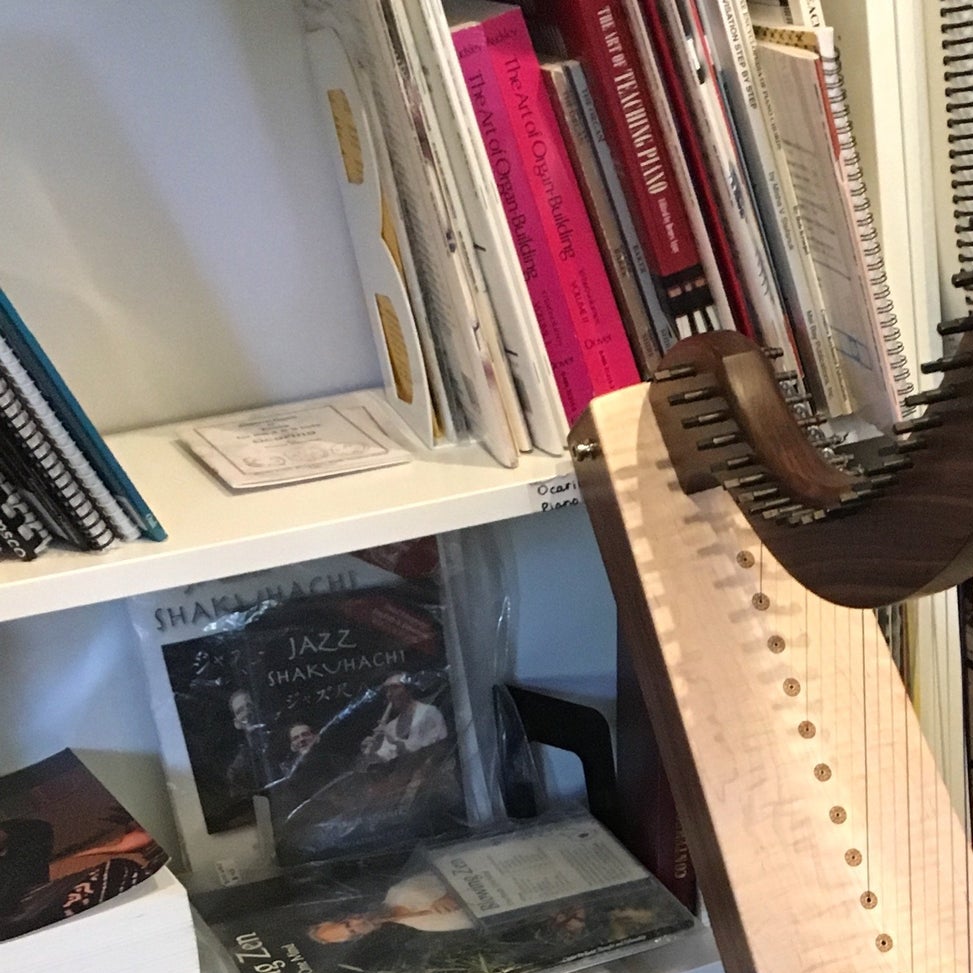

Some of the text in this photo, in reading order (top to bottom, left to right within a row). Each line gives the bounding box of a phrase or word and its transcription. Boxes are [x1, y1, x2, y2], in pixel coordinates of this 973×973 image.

[597, 5, 614, 31] THE
[604, 33, 622, 57] ART
[612, 53, 626, 69] OF
[734, 40, 746, 68] STEP
[741, 70, 751, 83] BY
[746, 85, 757, 109] STEP
[614, 69, 652, 148] TEACHING
[469, 70, 486, 99] The
[478, 107, 497, 135] Art
[489, 138, 505, 156] of
[497, 158, 537, 281] Organ-Building
[504, 58, 576, 262] The Art of Organ-Building
[638, 147, 668, 195] PIANO
[537, 480, 577, 495] Ocari
[542, 498, 579, 512] Piano
[288, 629, 357, 659] JAZZ
[268, 650, 405, 687] SHAKUHACHI
[449, 856, 500, 911] Blowing Zen
[235, 931, 270, 963] Zen
